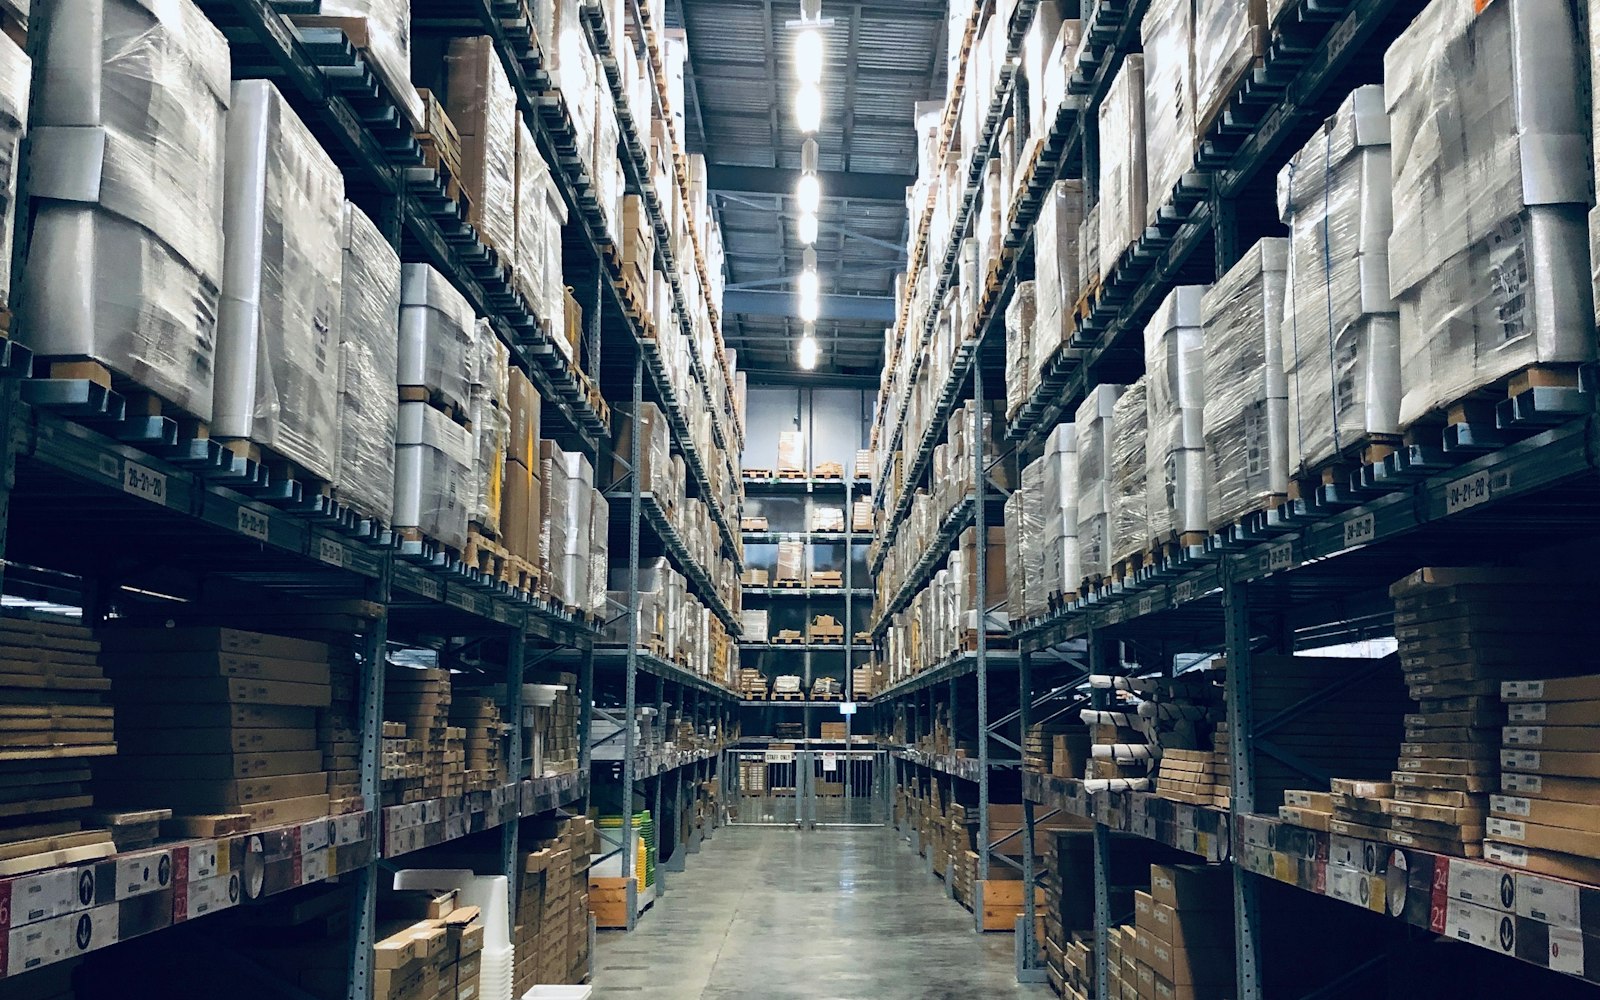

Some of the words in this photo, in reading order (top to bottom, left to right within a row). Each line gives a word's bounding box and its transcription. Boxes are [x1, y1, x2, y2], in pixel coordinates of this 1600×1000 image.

[1451, 476, 1485, 506] 24-21-20
[1434, 868, 1447, 890] 24
[1431, 906, 1444, 928] 21
